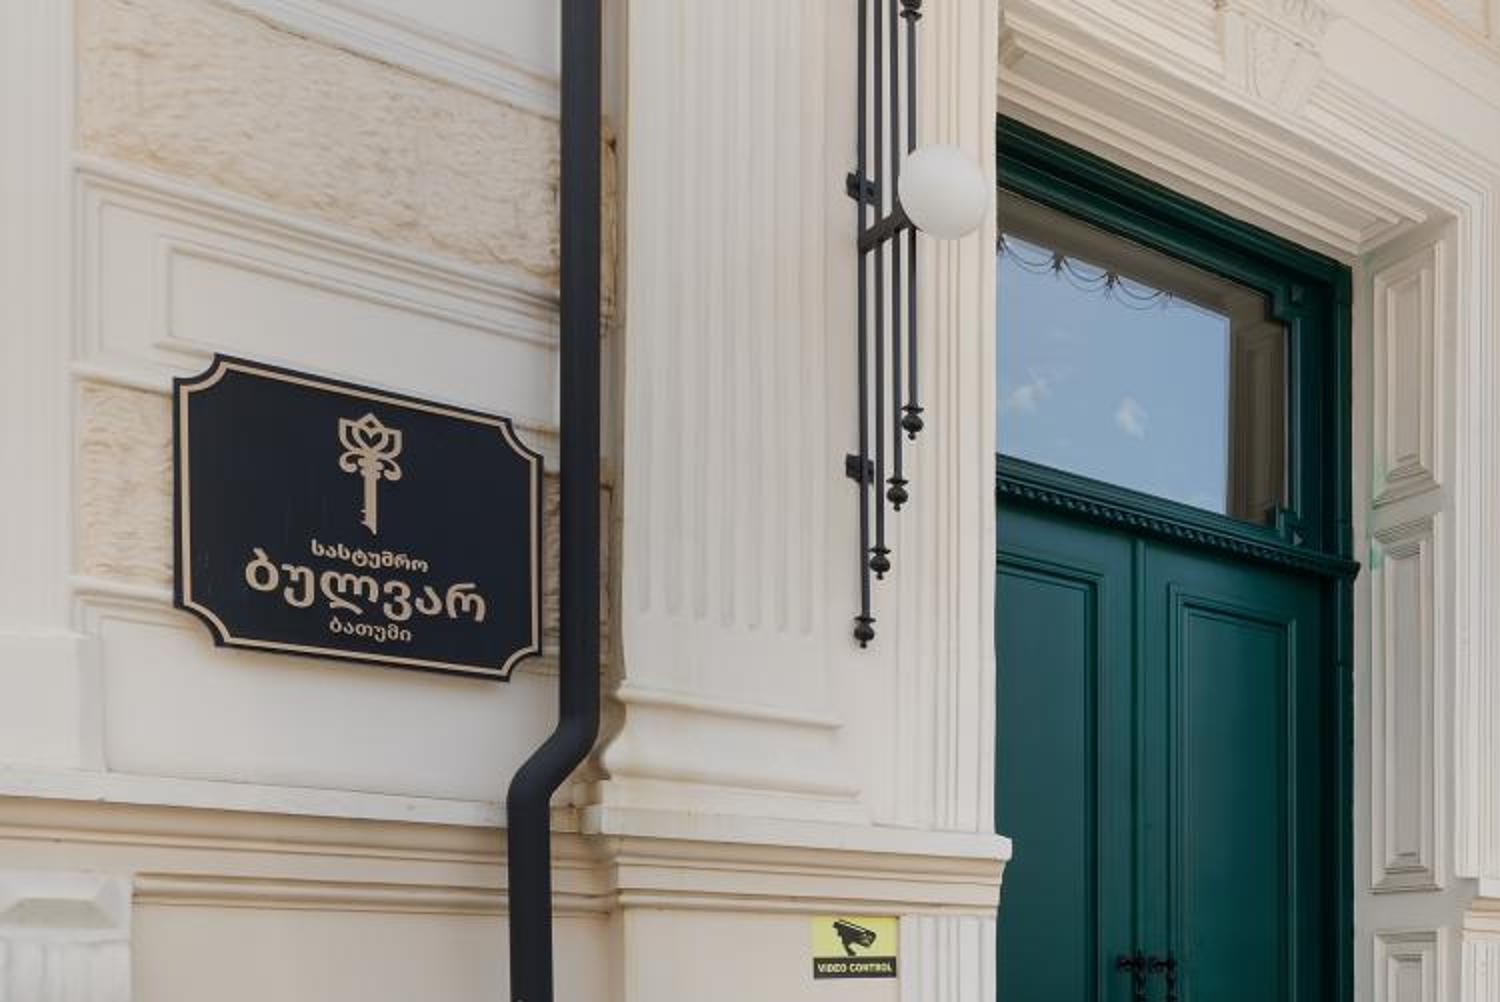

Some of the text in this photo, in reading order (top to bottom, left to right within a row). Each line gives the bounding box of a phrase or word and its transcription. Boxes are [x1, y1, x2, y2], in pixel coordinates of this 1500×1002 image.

[311, 538, 429, 573] სასტუმრო
[245, 547, 486, 622] ბულვარ
[329, 615, 412, 643] ბათუმი
[817, 963, 893, 973] VIDEO CONTROL
